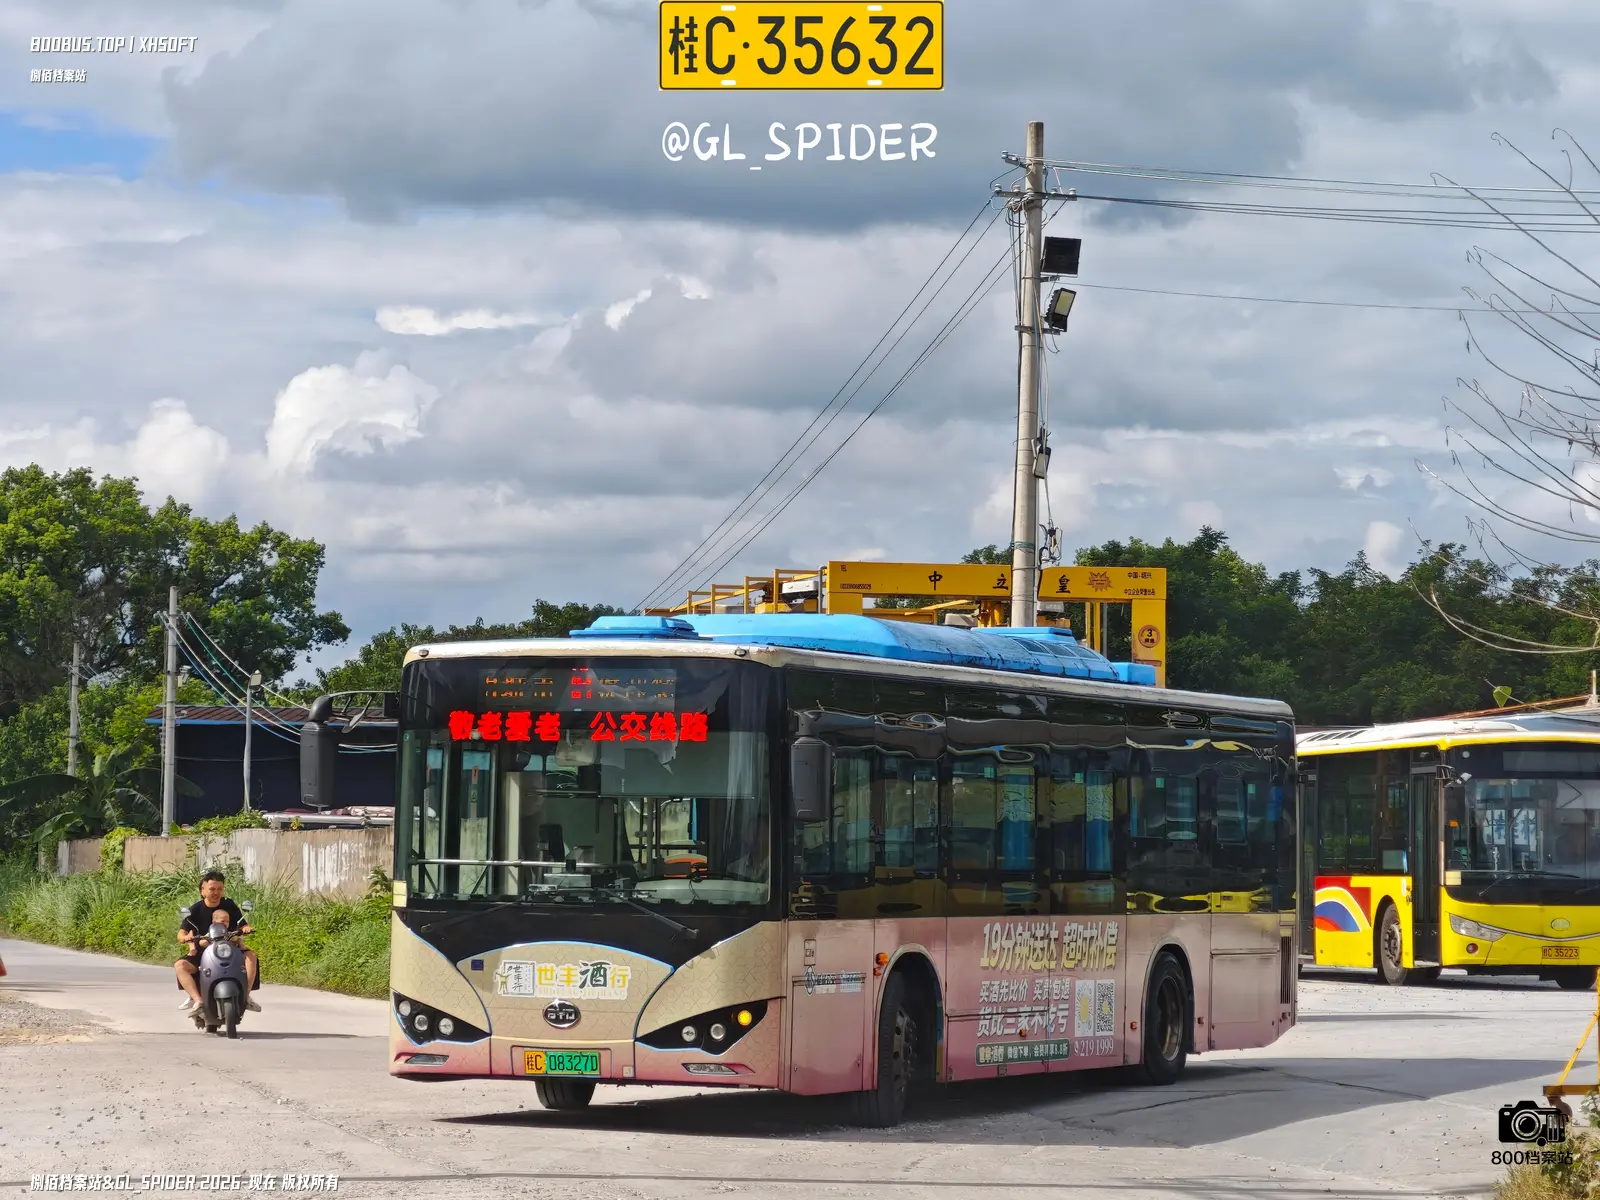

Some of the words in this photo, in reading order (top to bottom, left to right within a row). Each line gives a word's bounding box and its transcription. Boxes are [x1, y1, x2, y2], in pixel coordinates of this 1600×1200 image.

[1146, 628, 1153, 638] 3
[448, 710, 561, 741] 敬老爱老
[589, 711, 709, 742] 公交线路
[980, 921, 1059, 972] 19分钟送达
[1061, 920, 1119, 972] 超时补偿
[979, 979, 1029, 1003] 买酒先比价
[1033, 977, 1072, 1002] 买贵包退
[976, 1003, 1070, 1038] 货比三家不吃亏
